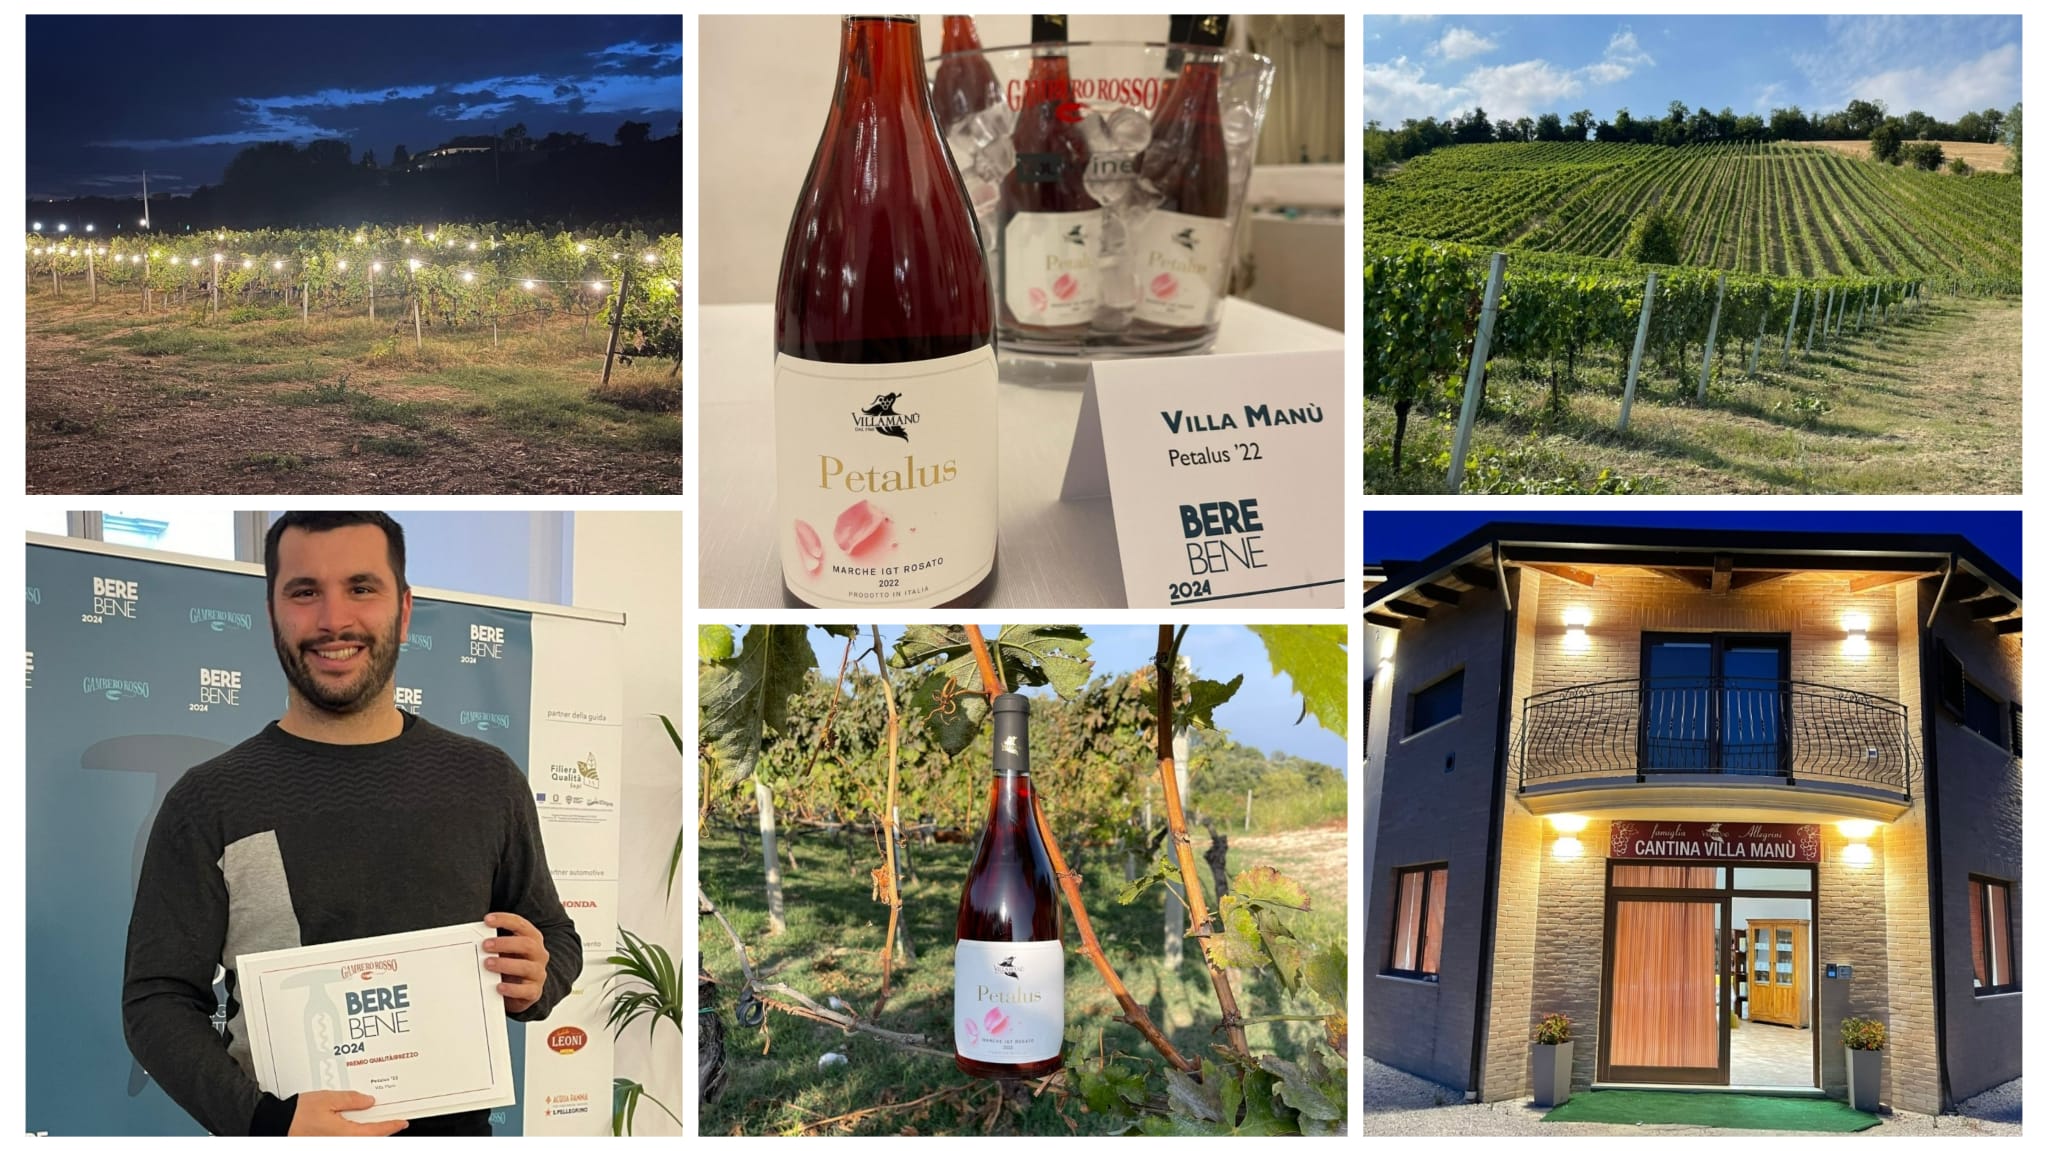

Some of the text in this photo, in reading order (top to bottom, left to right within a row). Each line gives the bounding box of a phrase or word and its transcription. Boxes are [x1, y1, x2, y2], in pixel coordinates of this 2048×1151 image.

[1098, 78, 1159, 110] ROSSO
[1168, 446, 1231, 467] Petalus
[818, 454, 957, 493] Petalus
[1179, 498, 1264, 539] BERE
[1186, 536, 1268, 576] BENE
[832, 557, 943, 576] MARCHE IGT ROSATO
[93, 576, 138, 600] BERE
[848, 591, 890, 599] PRODOTTO
[904, 586, 929, 597] ITALIA
[879, 579, 900, 588] 2022
[1169, 579, 1212, 600] 2024
[94, 596, 137, 619] BENE
[81, 614, 103, 624] 2024
[189, 608, 252, 630] GAMBERO ROSSO
[470, 624, 505, 644] BERE
[470, 641, 503, 659] BENE
[83, 677, 150, 698] GAMBERO ROSSO
[200, 668, 242, 689] BERE
[200, 687, 239, 706] BENE
[189, 703, 209, 712] 2024
[547, 710, 571, 719] partner
[550, 764, 577, 774] Filiera
[1635, 840, 1796, 858] CANTINA VILLA MANÙ
[341, 959, 398, 979] GAMBERO ROSSO
[345, 984, 410, 1016] BERE
[977, 985, 1042, 1004] Petalus
[348, 1011, 410, 1040] BENE
[333, 1041, 365, 1056] 2024
[551, 1035, 582, 1047] LEONI
[346, 1058, 368, 1067] PREMIO
